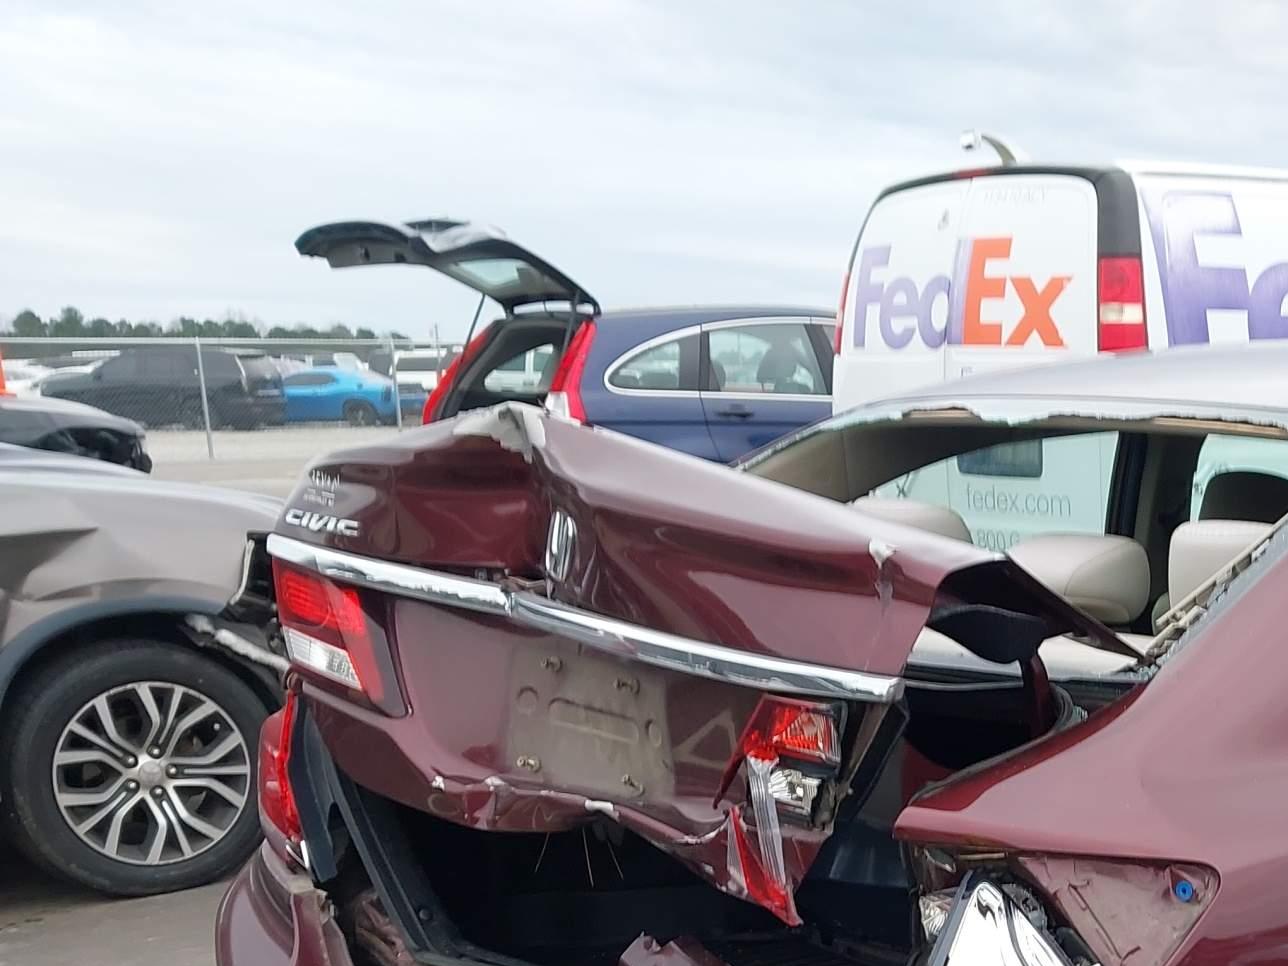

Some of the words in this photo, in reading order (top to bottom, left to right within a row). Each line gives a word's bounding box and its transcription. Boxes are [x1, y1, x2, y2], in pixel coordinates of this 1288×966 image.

[853, 236, 1073, 350] FedEx
[967, 484, 1071, 517] fedex.com
[286, 508, 359, 536] CIVIC
